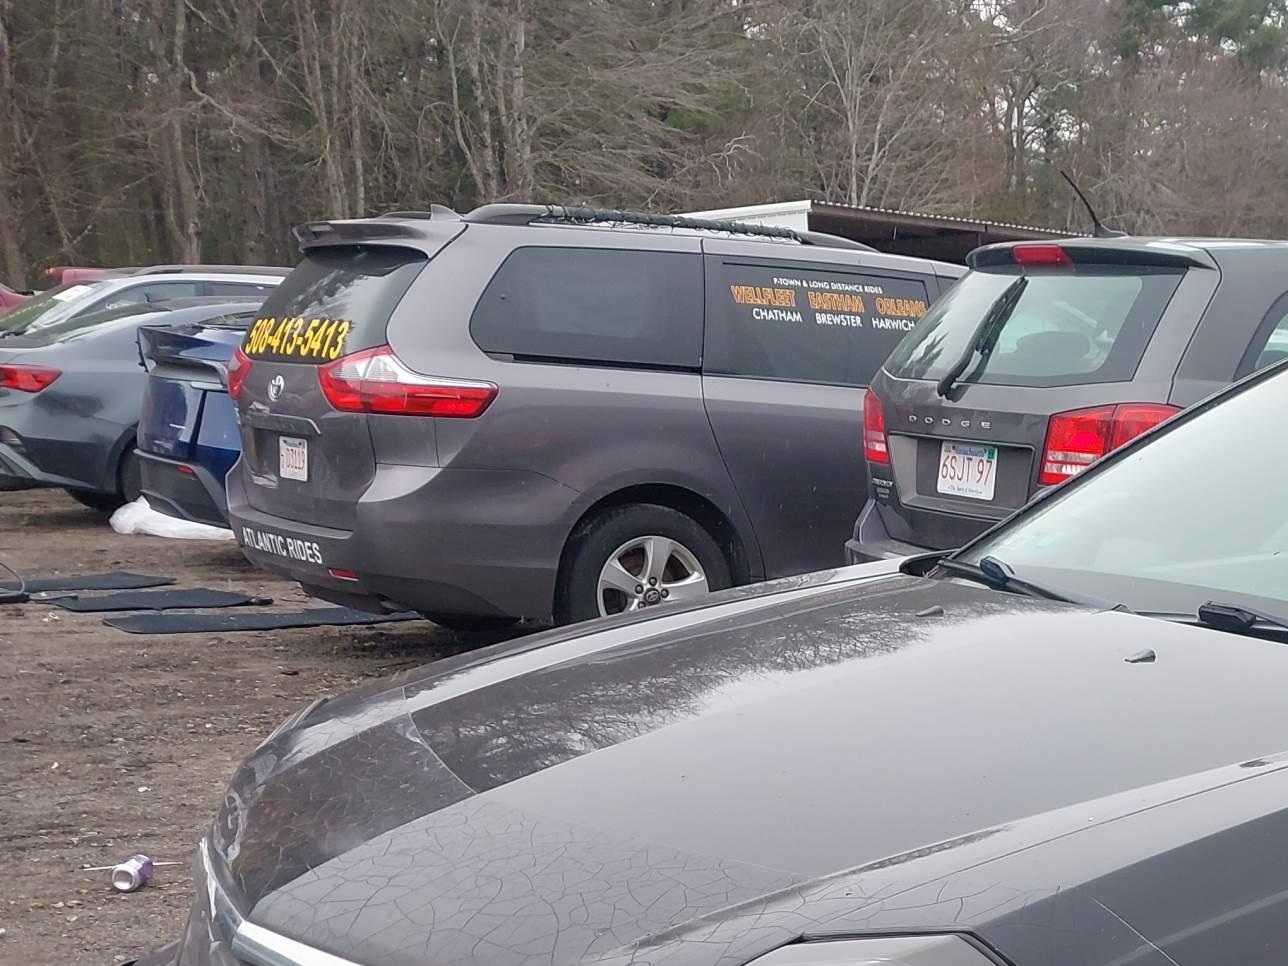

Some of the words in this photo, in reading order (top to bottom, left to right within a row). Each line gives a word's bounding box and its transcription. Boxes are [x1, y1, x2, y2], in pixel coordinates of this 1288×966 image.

[731, 285, 796, 307] WELLFLEET
[808, 291, 865, 313] EASTHAM
[802, 279, 808, 288] &
[809, 280, 829, 290] LONG
[831, 282, 863, 293] DISTANCE
[864, 285, 883, 295] RIDES
[753, 307, 803, 323] CHATHAM
[816, 313, 862, 328] BREWSTER
[245, 318, 349, 360] 508-413-5413
[908, 415, 992, 429] DODGE
[941, 455, 973, 483] 6SJT
[976, 459, 993, 486] 97
[242, 526, 287, 557] ATLANTIC
[286, 537, 323, 565] RIDES
